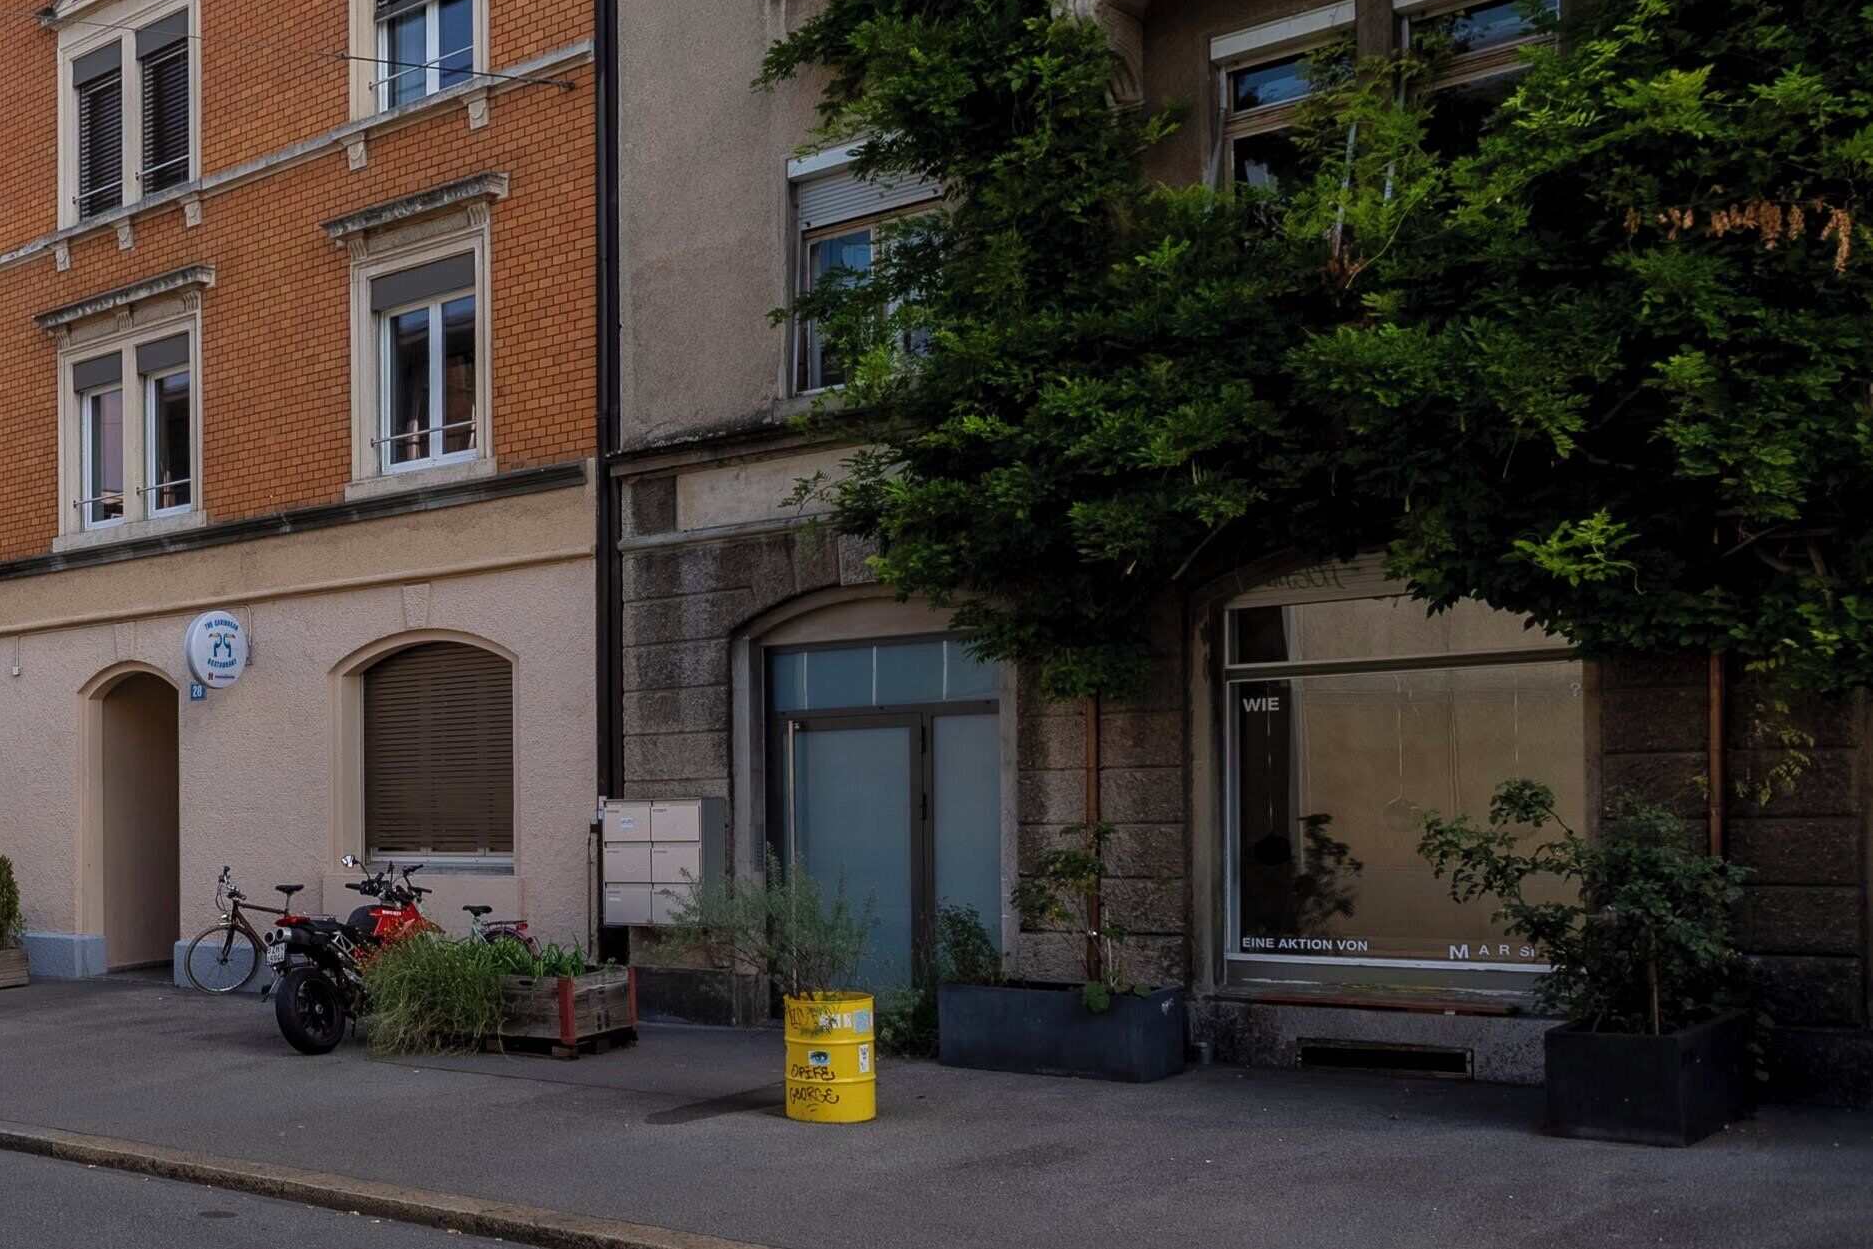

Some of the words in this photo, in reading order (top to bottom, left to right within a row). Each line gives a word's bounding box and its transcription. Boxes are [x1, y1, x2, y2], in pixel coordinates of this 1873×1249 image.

[192, 684, 202, 698] 28
[1242, 697, 1280, 712] WIE
[1242, 937, 1275, 949] EINE
[1278, 938, 1333, 951] AKTION
[1337, 939, 1368, 952] VON
